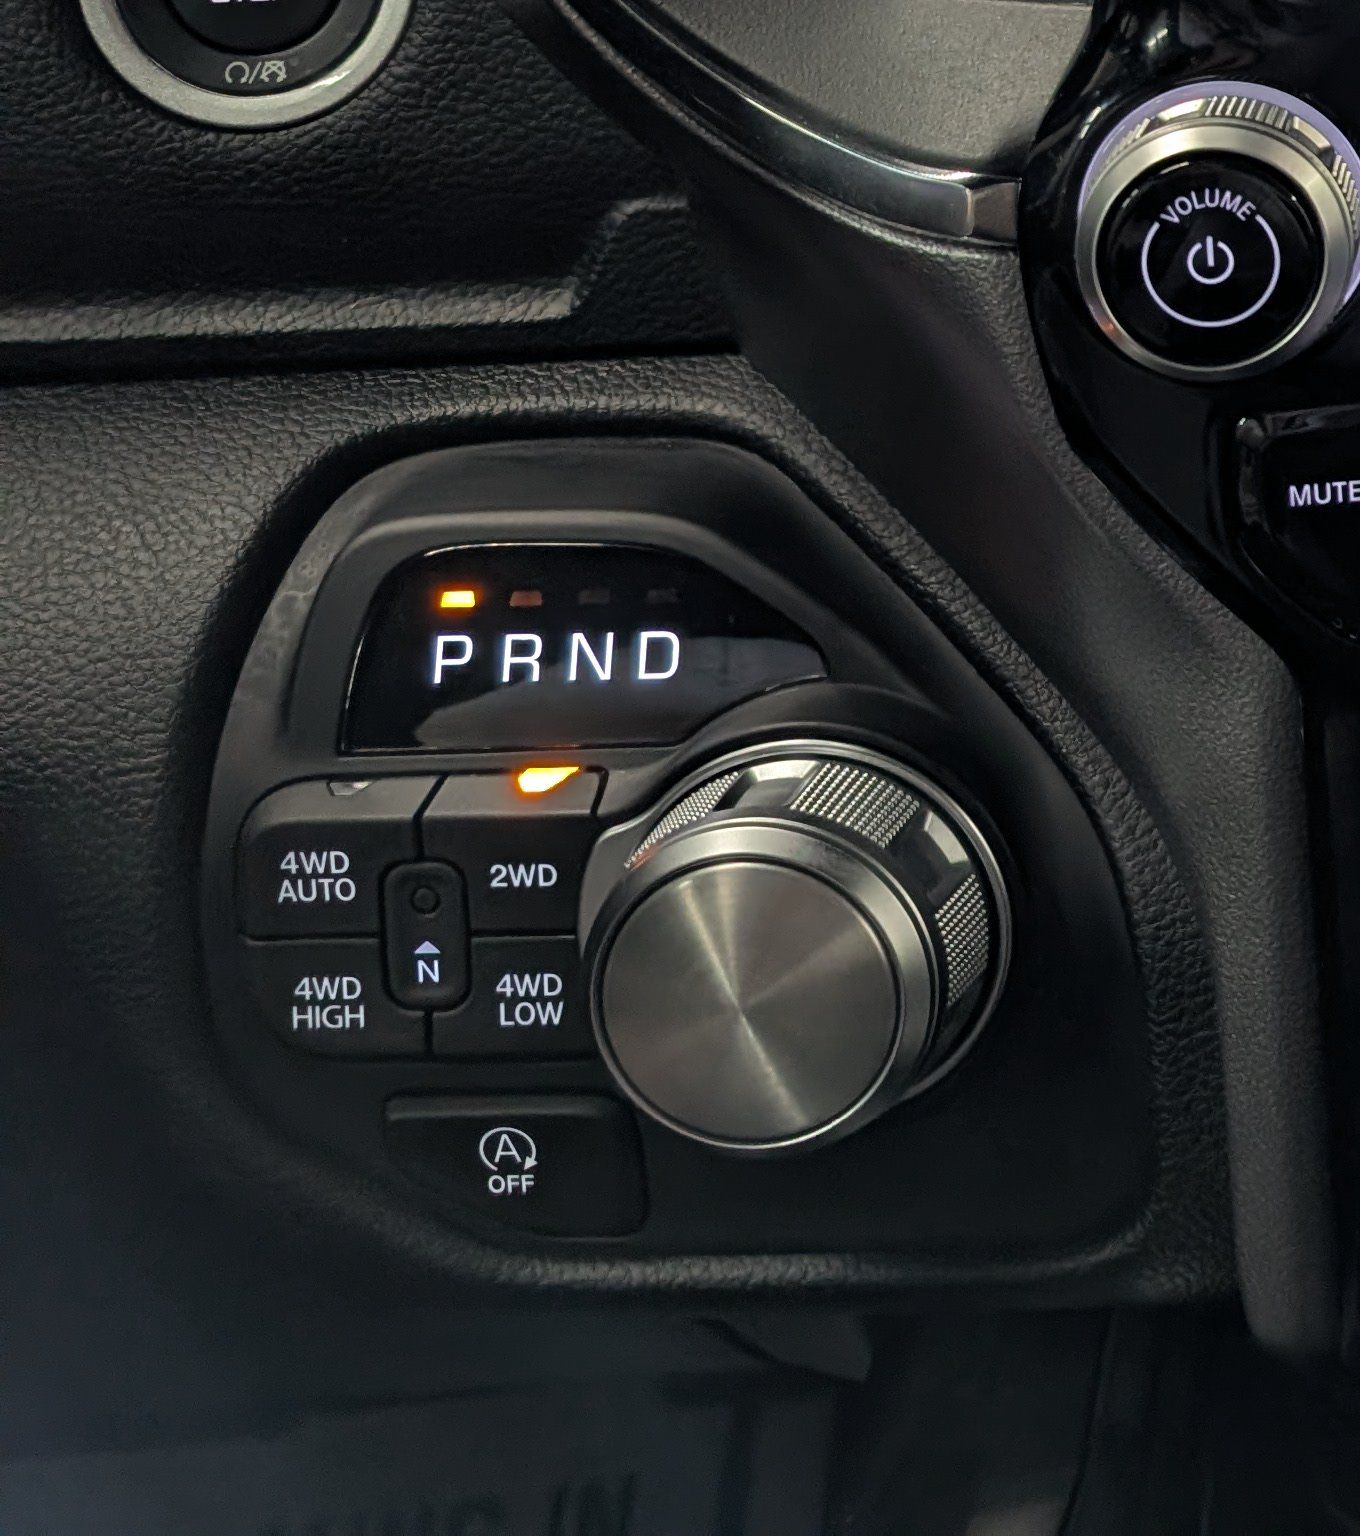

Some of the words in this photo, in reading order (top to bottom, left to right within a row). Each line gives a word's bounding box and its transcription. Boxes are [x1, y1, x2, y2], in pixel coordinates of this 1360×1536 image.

[1160, 186, 1257, 225] VOLUME
[433, 634, 474, 684] P
[501, 633, 543, 683] R
[567, 631, 614, 682] N
[637, 630, 680, 680] D
[280, 850, 350, 875] 4WD
[489, 863, 558, 888] 2WD
[278, 877, 356, 903] AUTO
[417, 959, 440, 983] N
[294, 976, 362, 1001] 4WD
[495, 973, 563, 997] 4WD
[292, 1004, 365, 1029] HIGH
[499, 1001, 564, 1026] LOW
[488, 1174, 535, 1194] OFF
